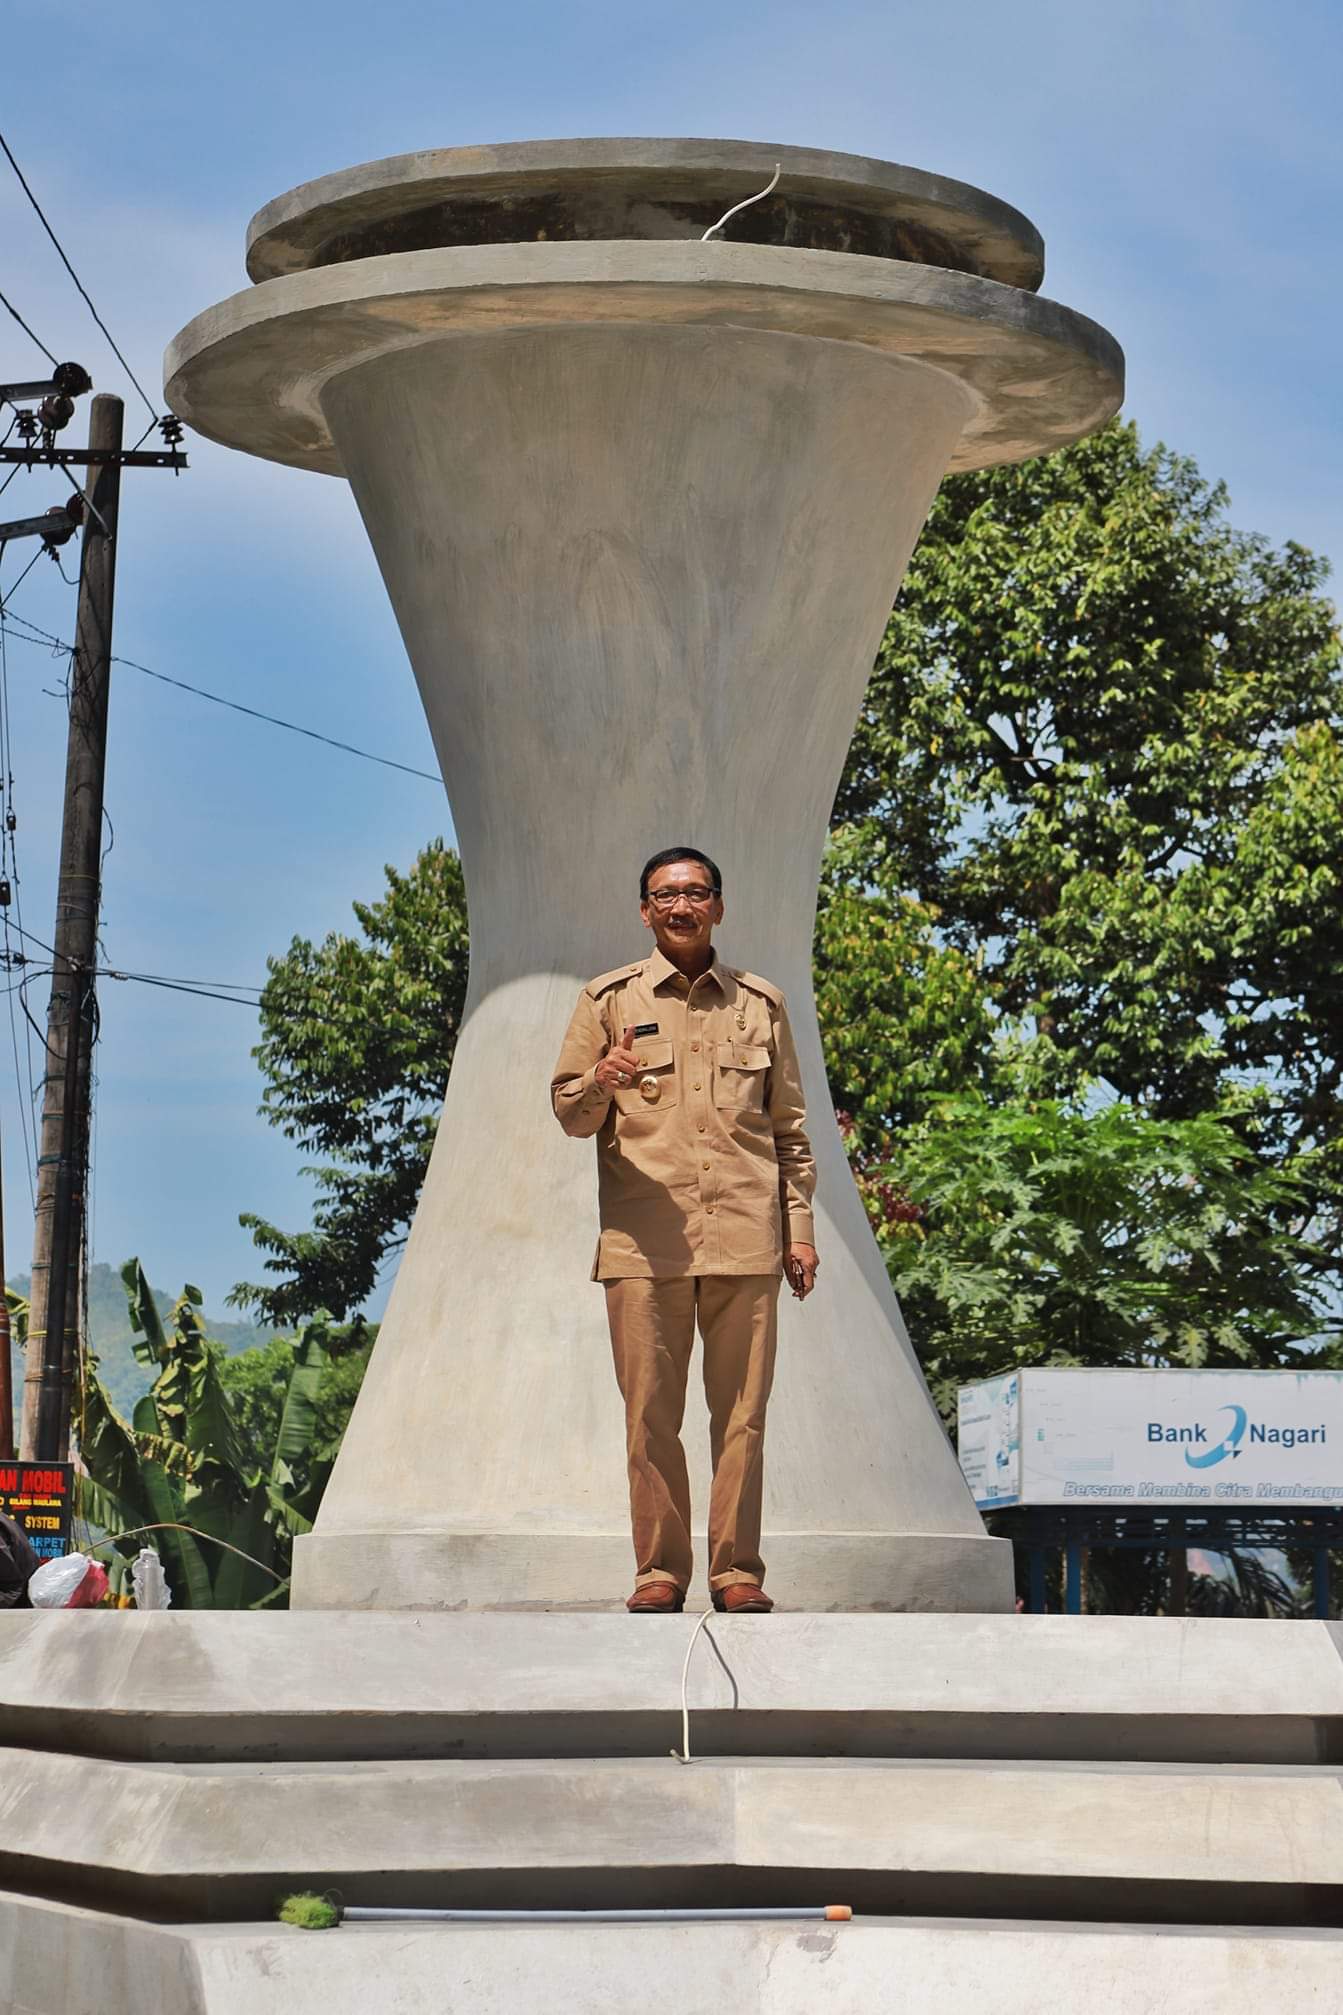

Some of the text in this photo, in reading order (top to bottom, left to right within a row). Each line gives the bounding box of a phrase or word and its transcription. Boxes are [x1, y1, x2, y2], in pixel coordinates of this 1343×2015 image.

[1147, 1423, 1326, 1448] Bank Nagari
[22, 1471, 65, 1492] MOBIL
[1063, 1482, 1134, 1497] Bersama
[1138, 1482, 1211, 1498] Membina
[1215, 1483, 1251, 1498] Citra
[24, 1515, 60, 1530] SYSTEM
